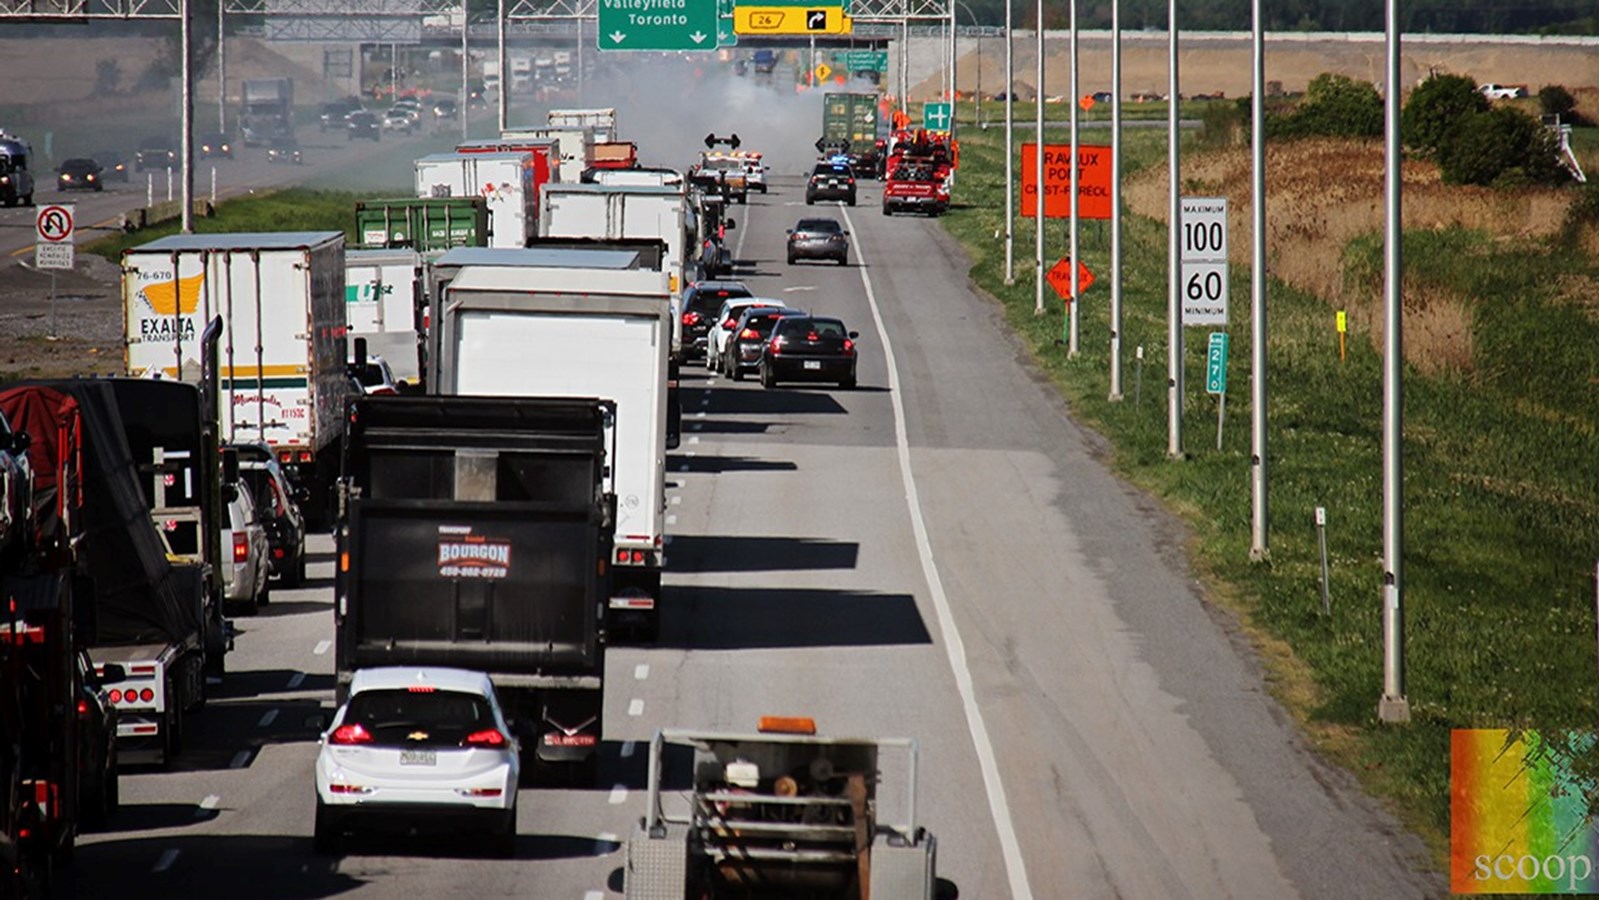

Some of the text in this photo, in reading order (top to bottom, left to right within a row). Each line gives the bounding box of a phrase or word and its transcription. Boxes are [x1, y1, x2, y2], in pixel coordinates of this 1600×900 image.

[604, 0, 686, 11] Valleyfield
[628, 13, 688, 26] Toronto
[758, 15, 772, 25] 26
[1044, 185, 1109, 197] ST-FRÉOL
[1184, 221, 1223, 251] 100
[1187, 271, 1222, 301] 60
[1184, 307, 1224, 315] MINIMUM
[141, 318, 195, 334] EXALTA
[439, 544, 509, 563] BOURGON
